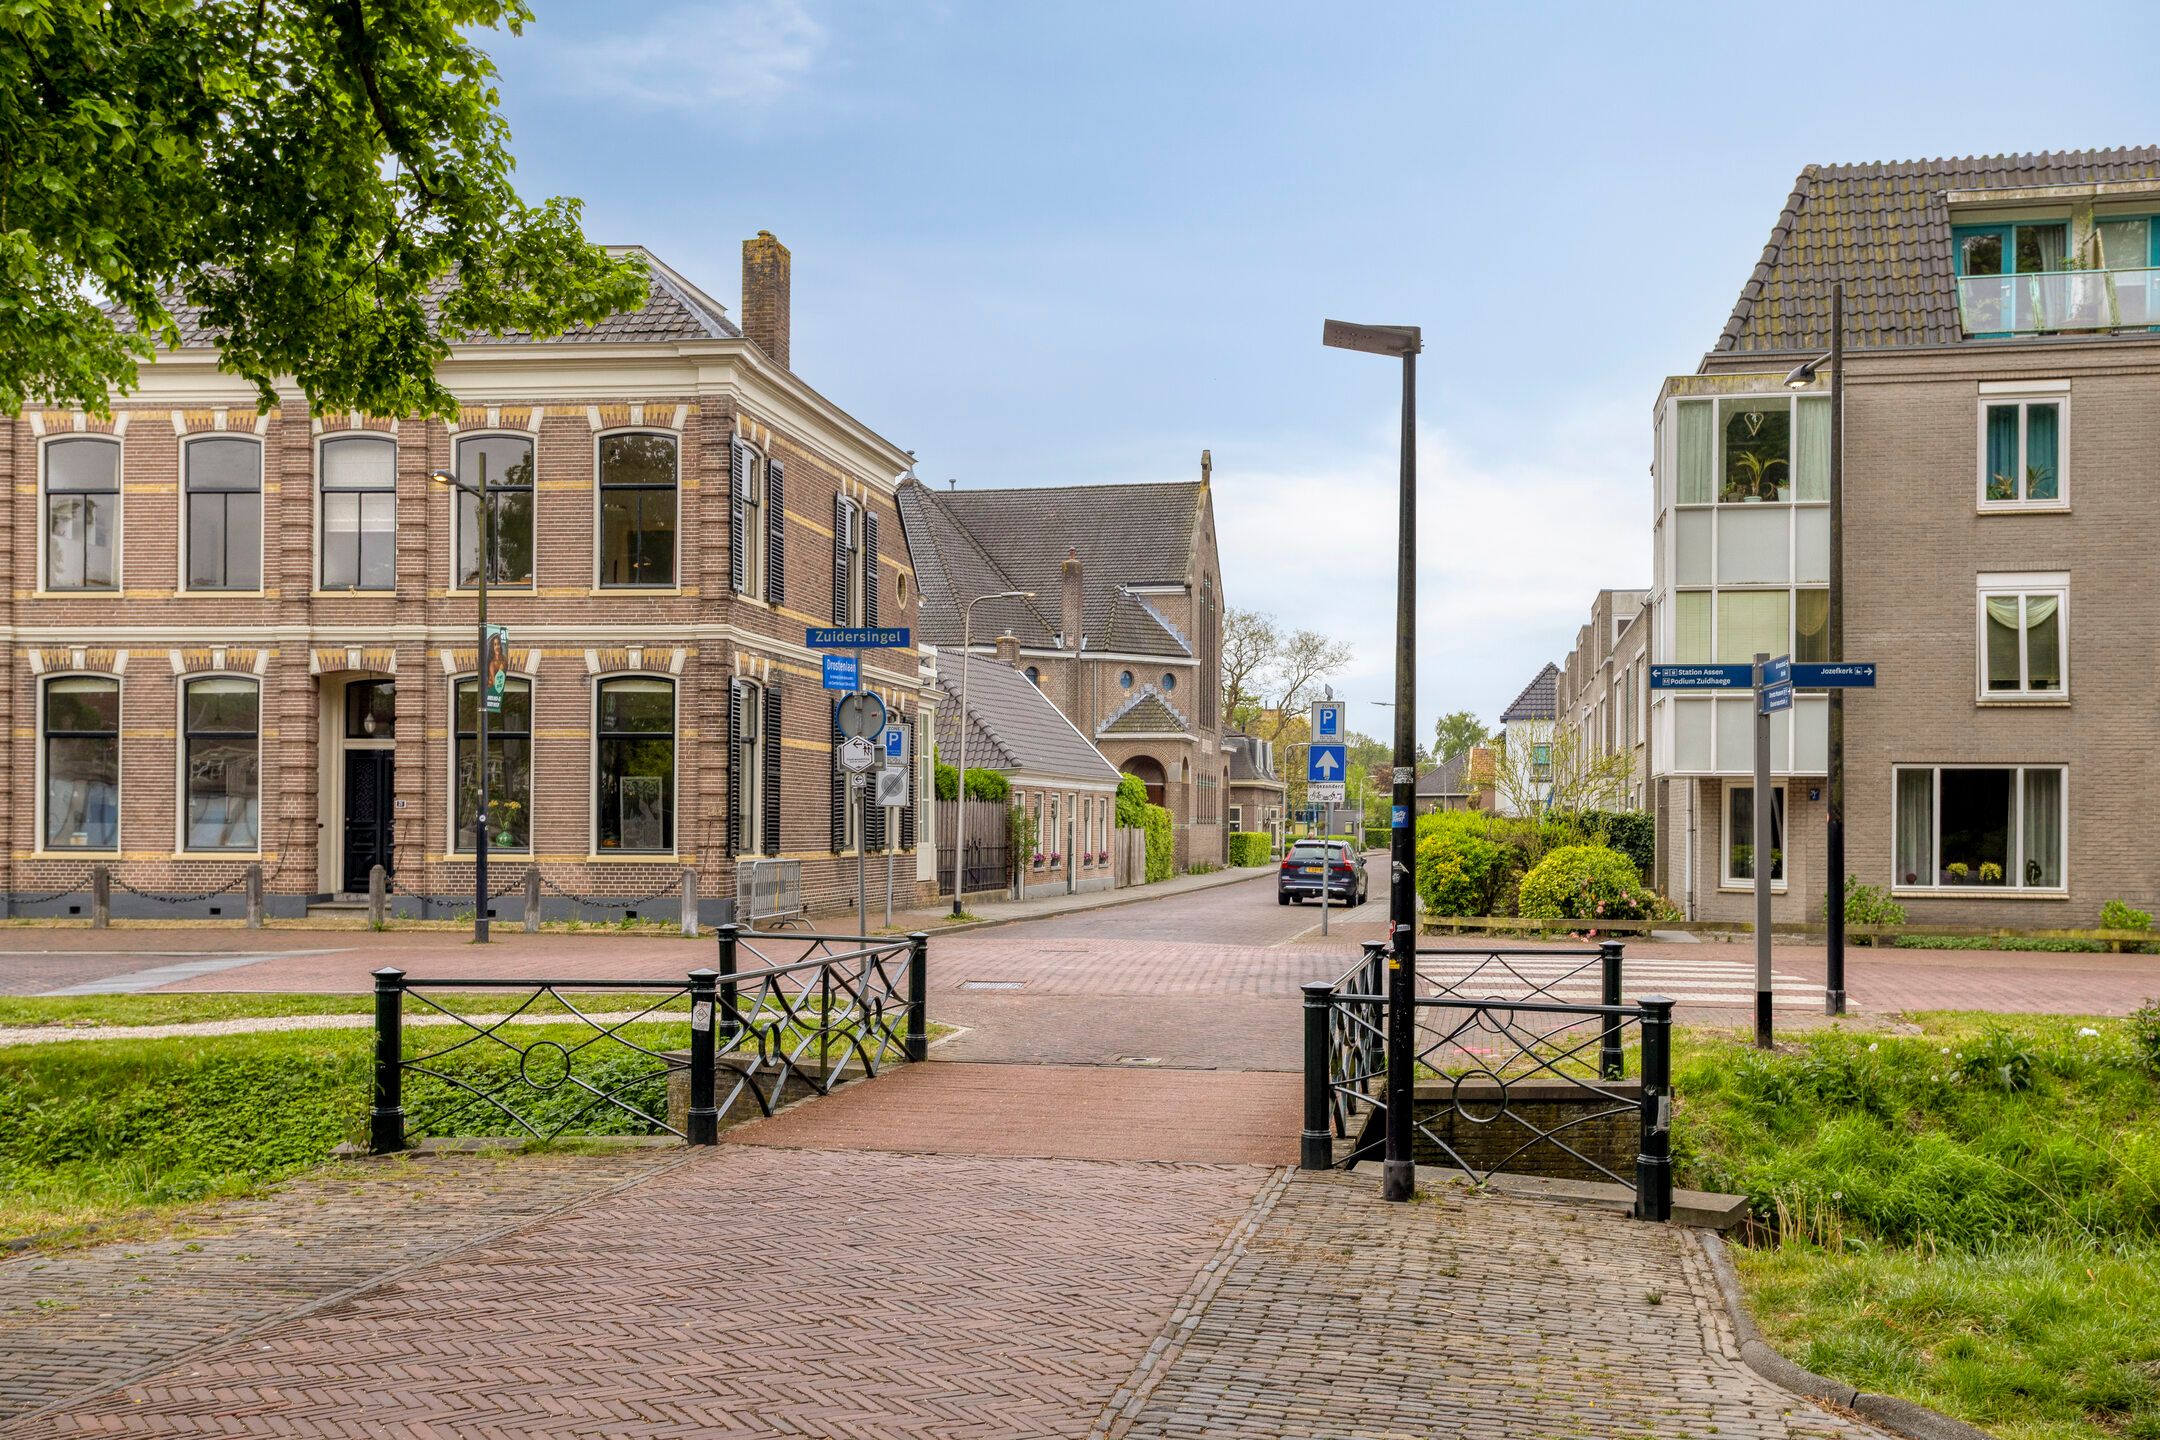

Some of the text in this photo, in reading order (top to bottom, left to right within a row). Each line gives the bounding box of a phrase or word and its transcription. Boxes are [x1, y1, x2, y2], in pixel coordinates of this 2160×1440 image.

[815, 630, 901, 644] Zuidersingel
[826, 659, 856, 672] Drostenlaan
[1678, 668, 1724, 676] Station Assen
[1820, 667, 1853, 675] Jozefkerk
[1670, 677, 1731, 686] Podium Zuidhaege
[1323, 710, 1334, 725] P
[889, 732, 899, 746] P
